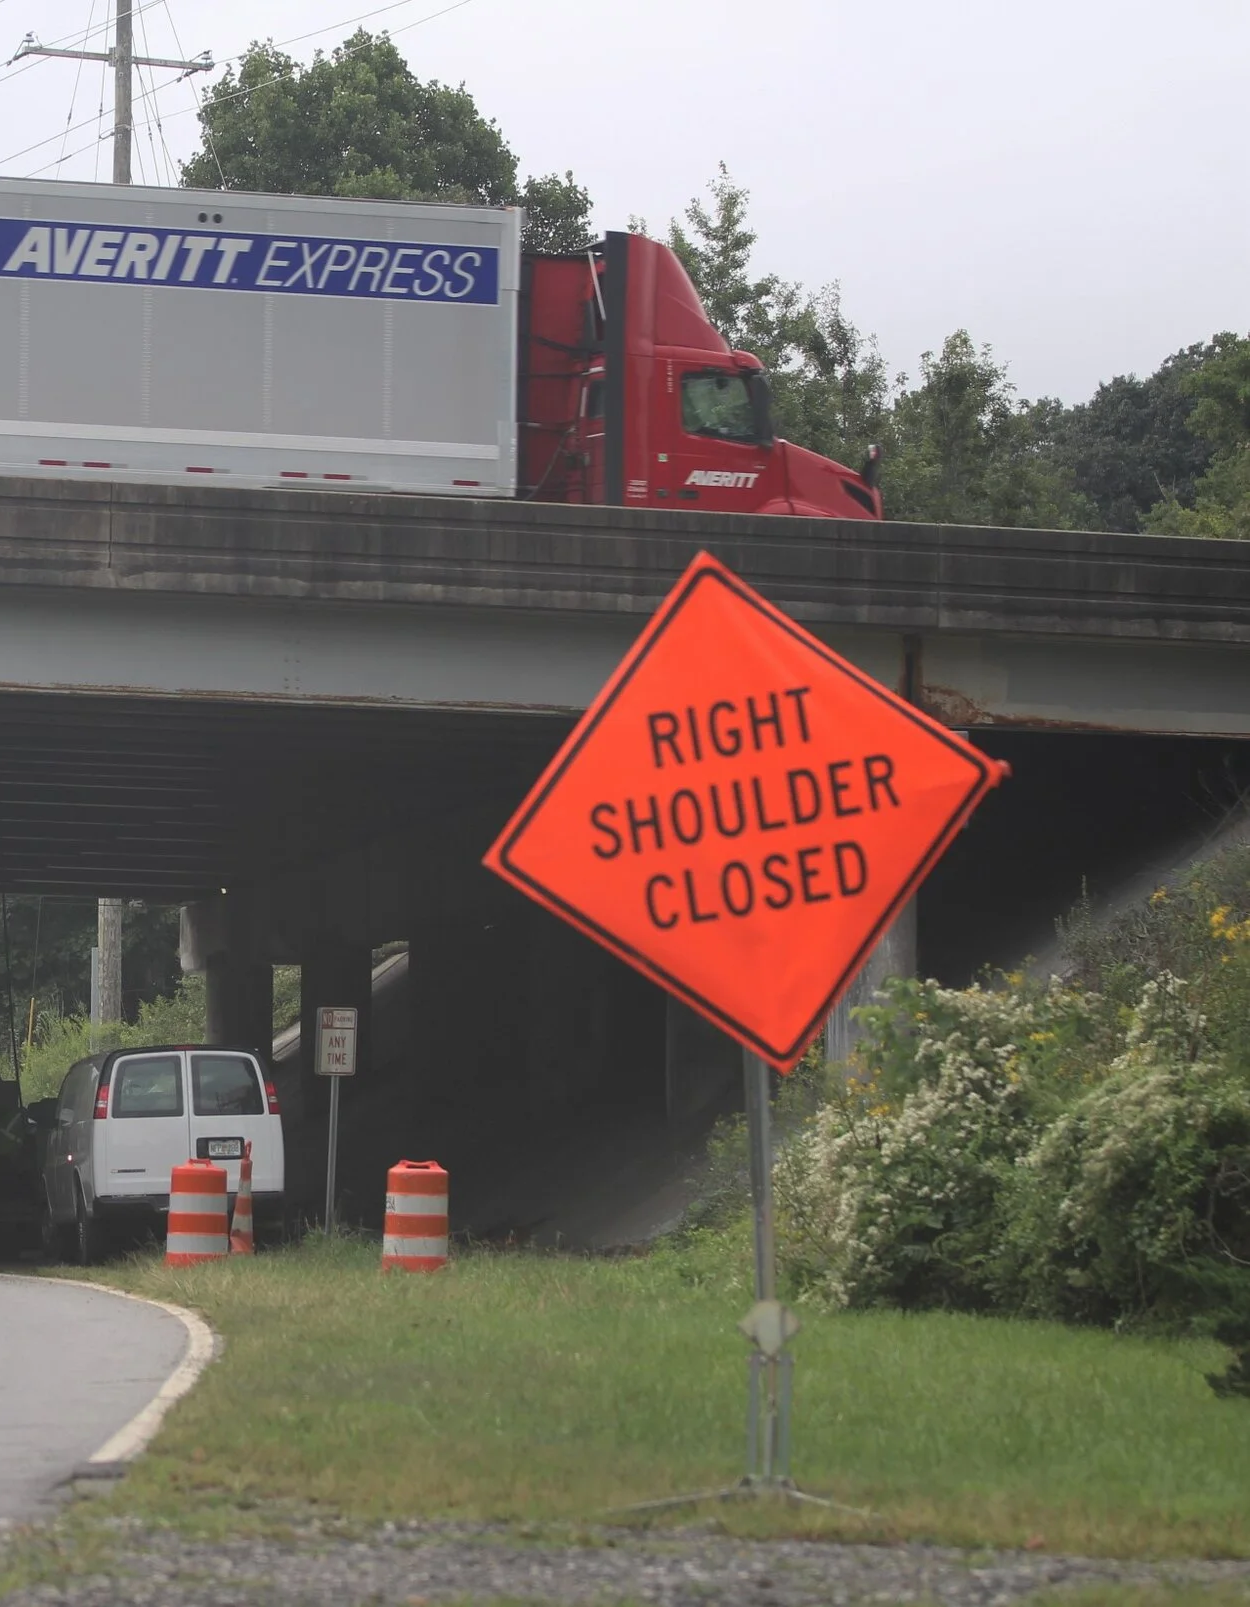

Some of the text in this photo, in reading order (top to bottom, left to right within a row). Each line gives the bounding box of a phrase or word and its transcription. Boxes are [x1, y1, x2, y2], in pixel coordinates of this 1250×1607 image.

[255, 241, 483, 298] EXPRESS
[684, 469, 760, 489] AVERITT
[647, 686, 812, 769] RIGHT
[589, 753, 901, 860] SHOULDER
[644, 840, 870, 931] CLOSED
[322, 1012, 333, 1026] NO
[327, 1052, 347, 1066] TIME
[328, 1036, 347, 1049] ANY
